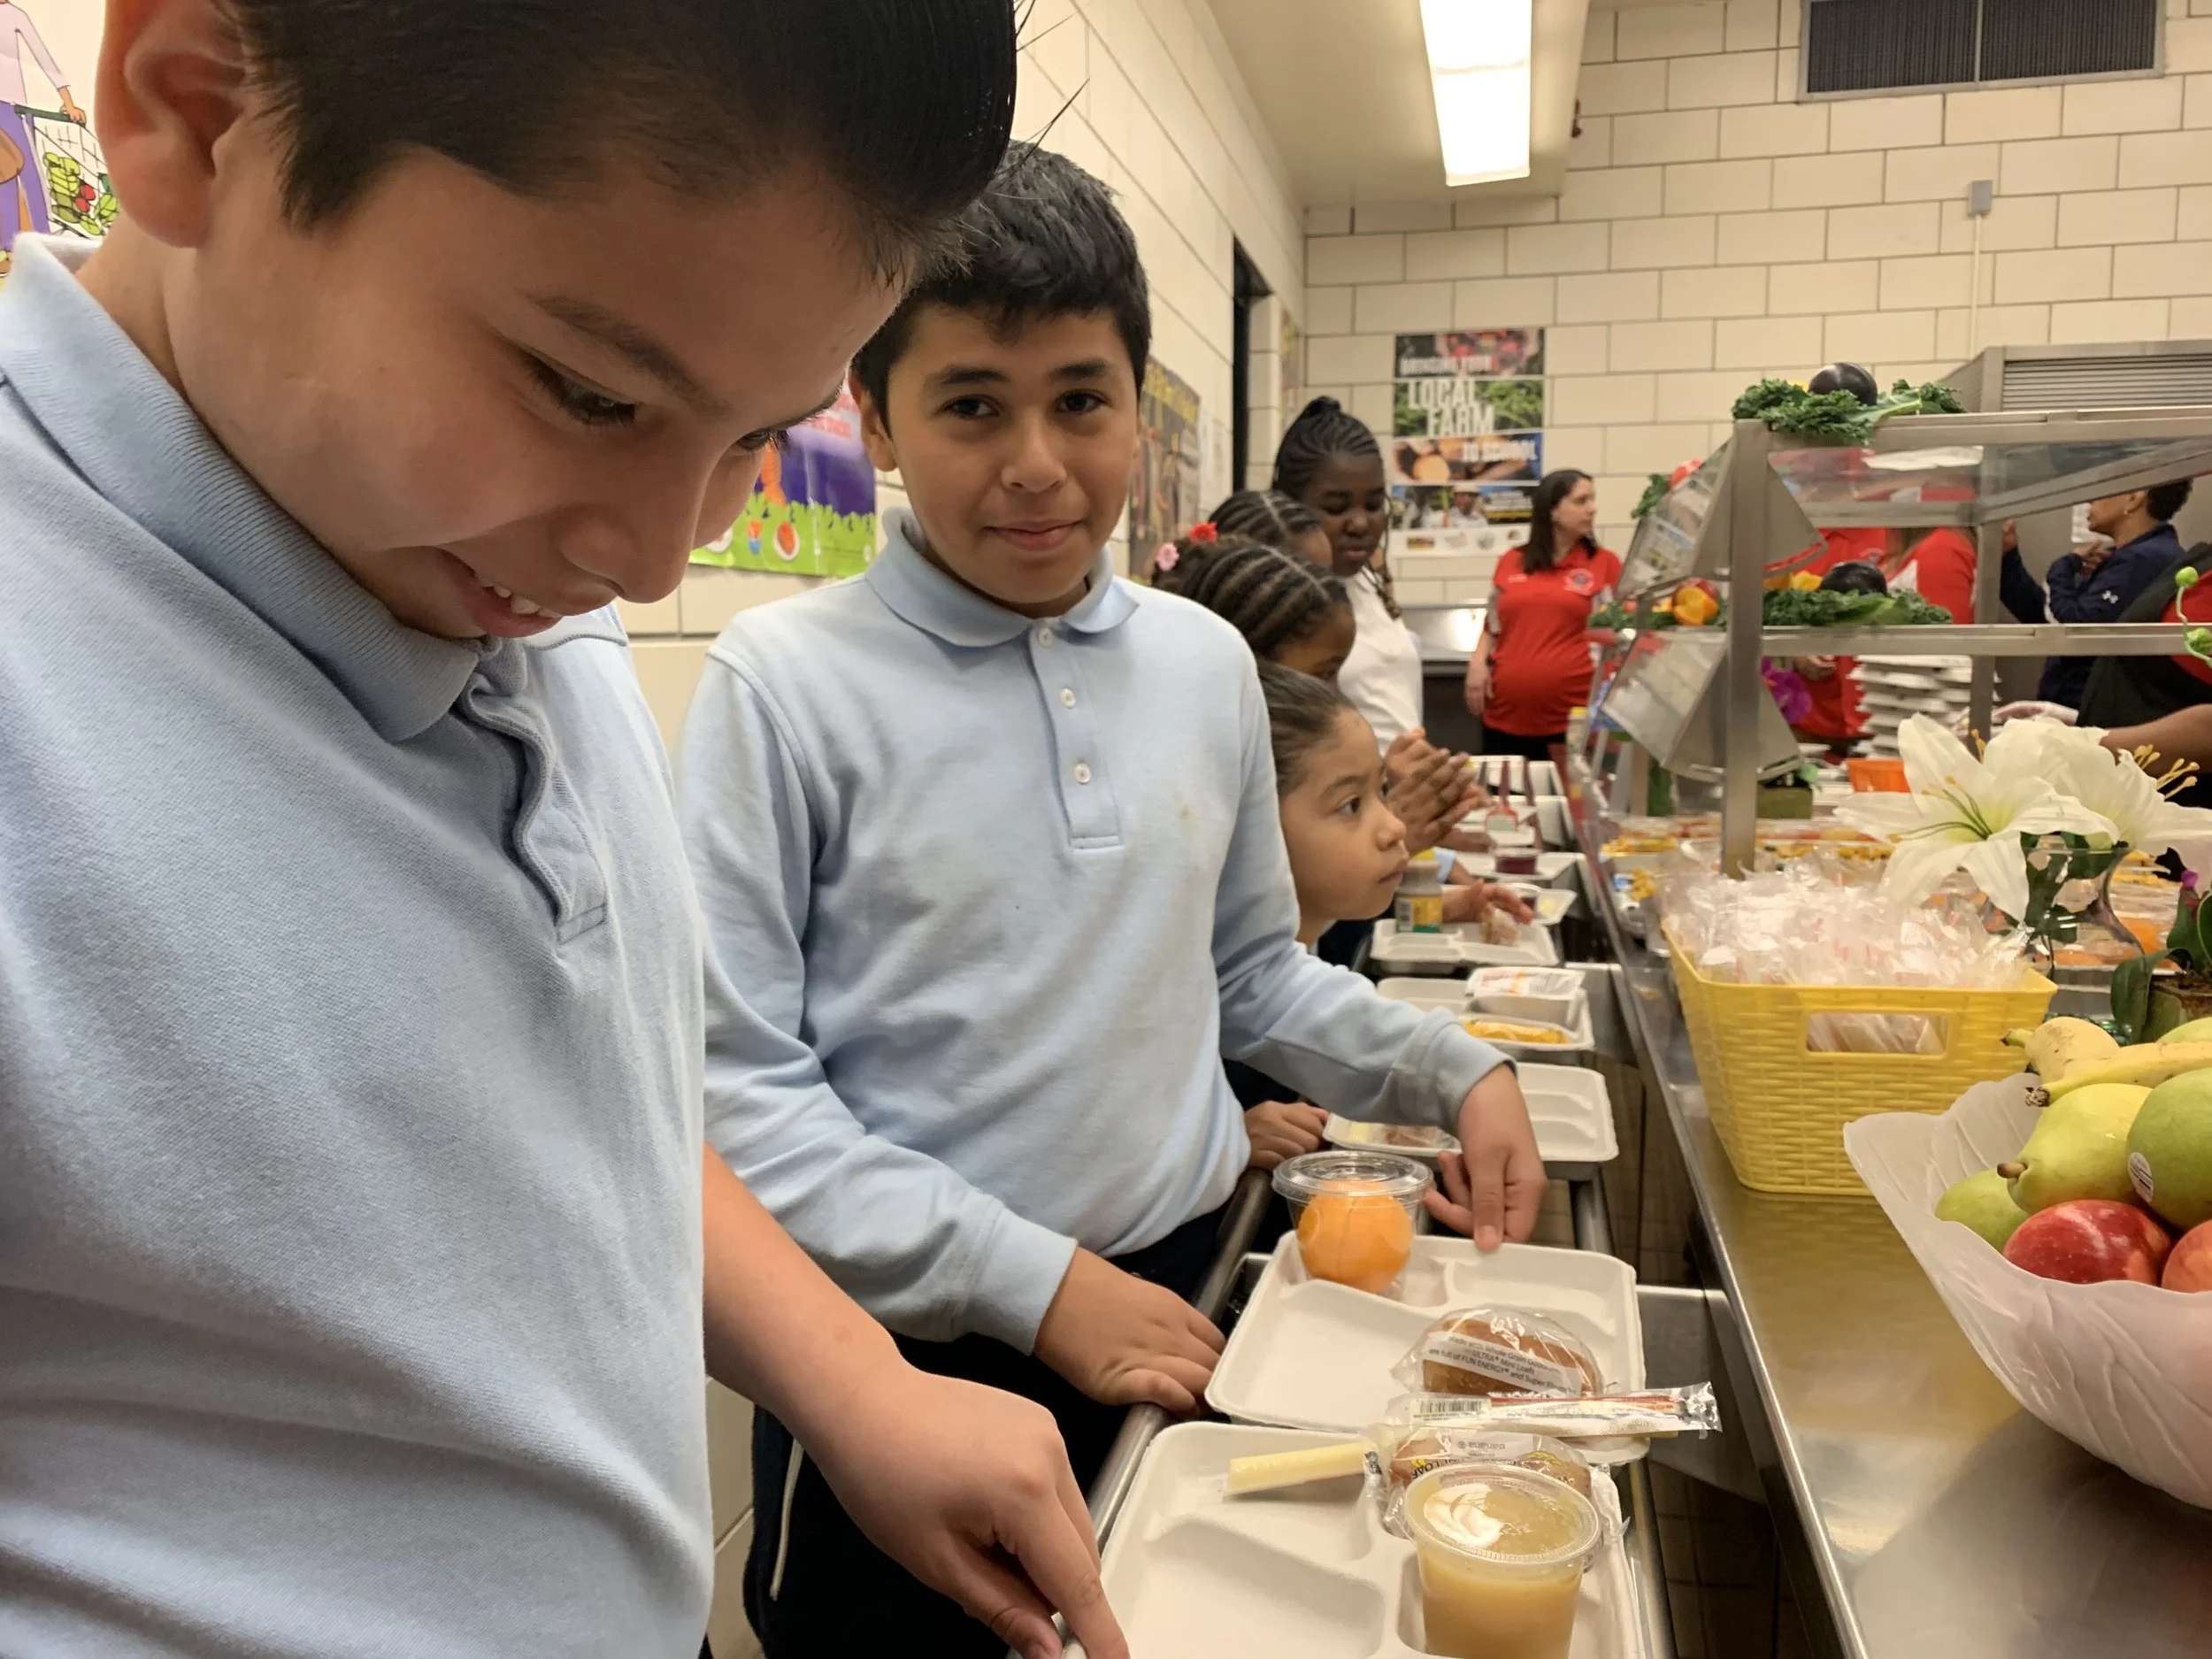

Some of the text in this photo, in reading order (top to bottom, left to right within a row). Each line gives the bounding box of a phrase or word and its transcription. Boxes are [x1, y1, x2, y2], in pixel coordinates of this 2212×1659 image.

[1408, 378, 1479, 410] LOCAL
[1426, 403, 1494, 439] FARM
[1411, 1460, 1440, 1479] LOAF
